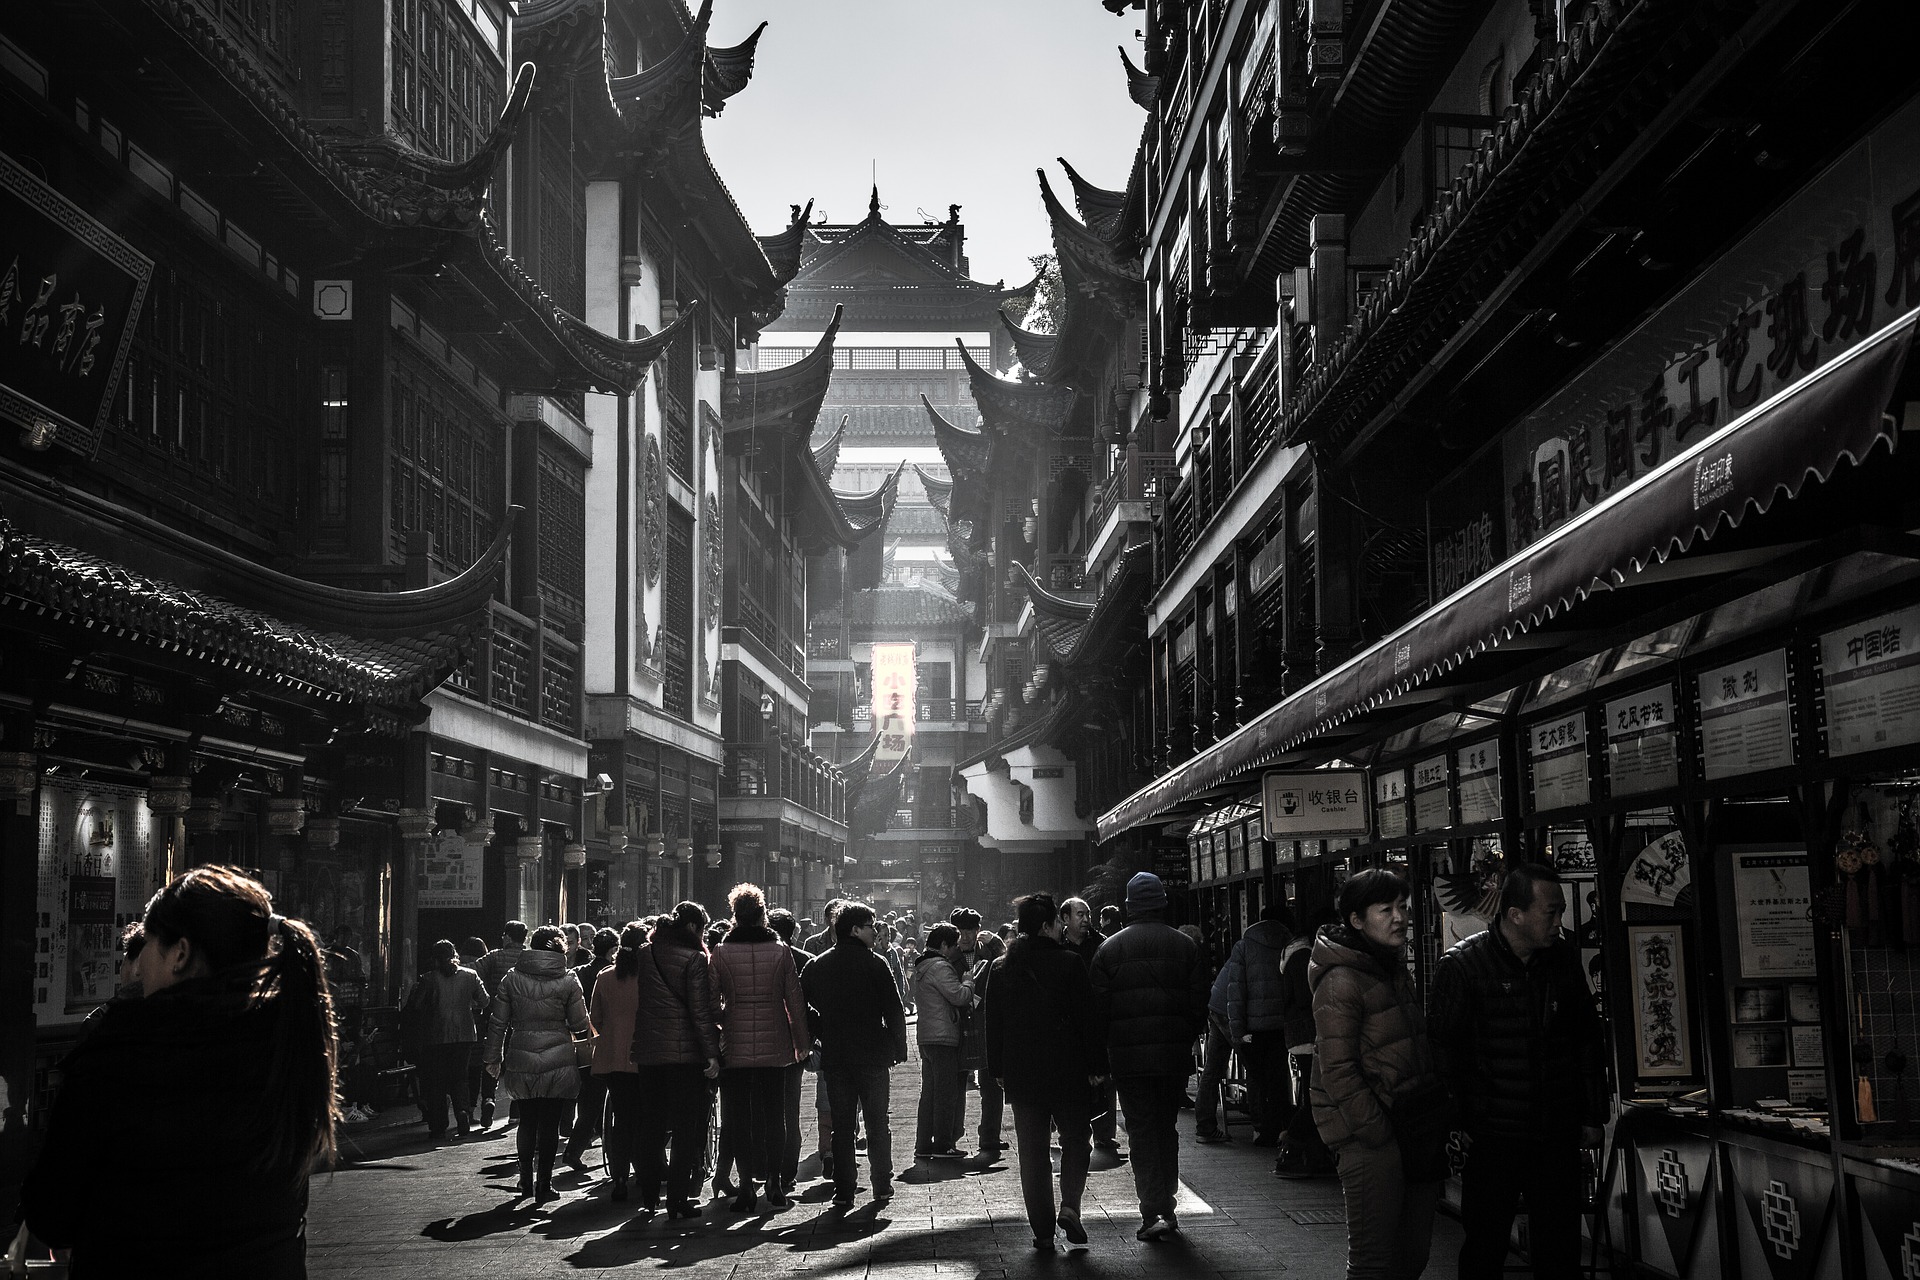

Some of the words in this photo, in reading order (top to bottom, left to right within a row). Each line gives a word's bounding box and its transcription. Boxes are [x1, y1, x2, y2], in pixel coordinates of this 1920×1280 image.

[1847, 625, 1901, 666] 中国结
[1873, 662, 1898, 673] Knotting
[1722, 668, 1758, 700] 微刻
[882, 671, 907, 753] 小吃广场
[1617, 701, 1664, 730] 龙凤书法
[1538, 720, 1578, 750] 艺术剪影
[1308, 788, 1359, 806] 收银台
[72, 852, 103, 877] 五香豆
[1750, 897, 1810, 906] 大世界基尼斯之最
